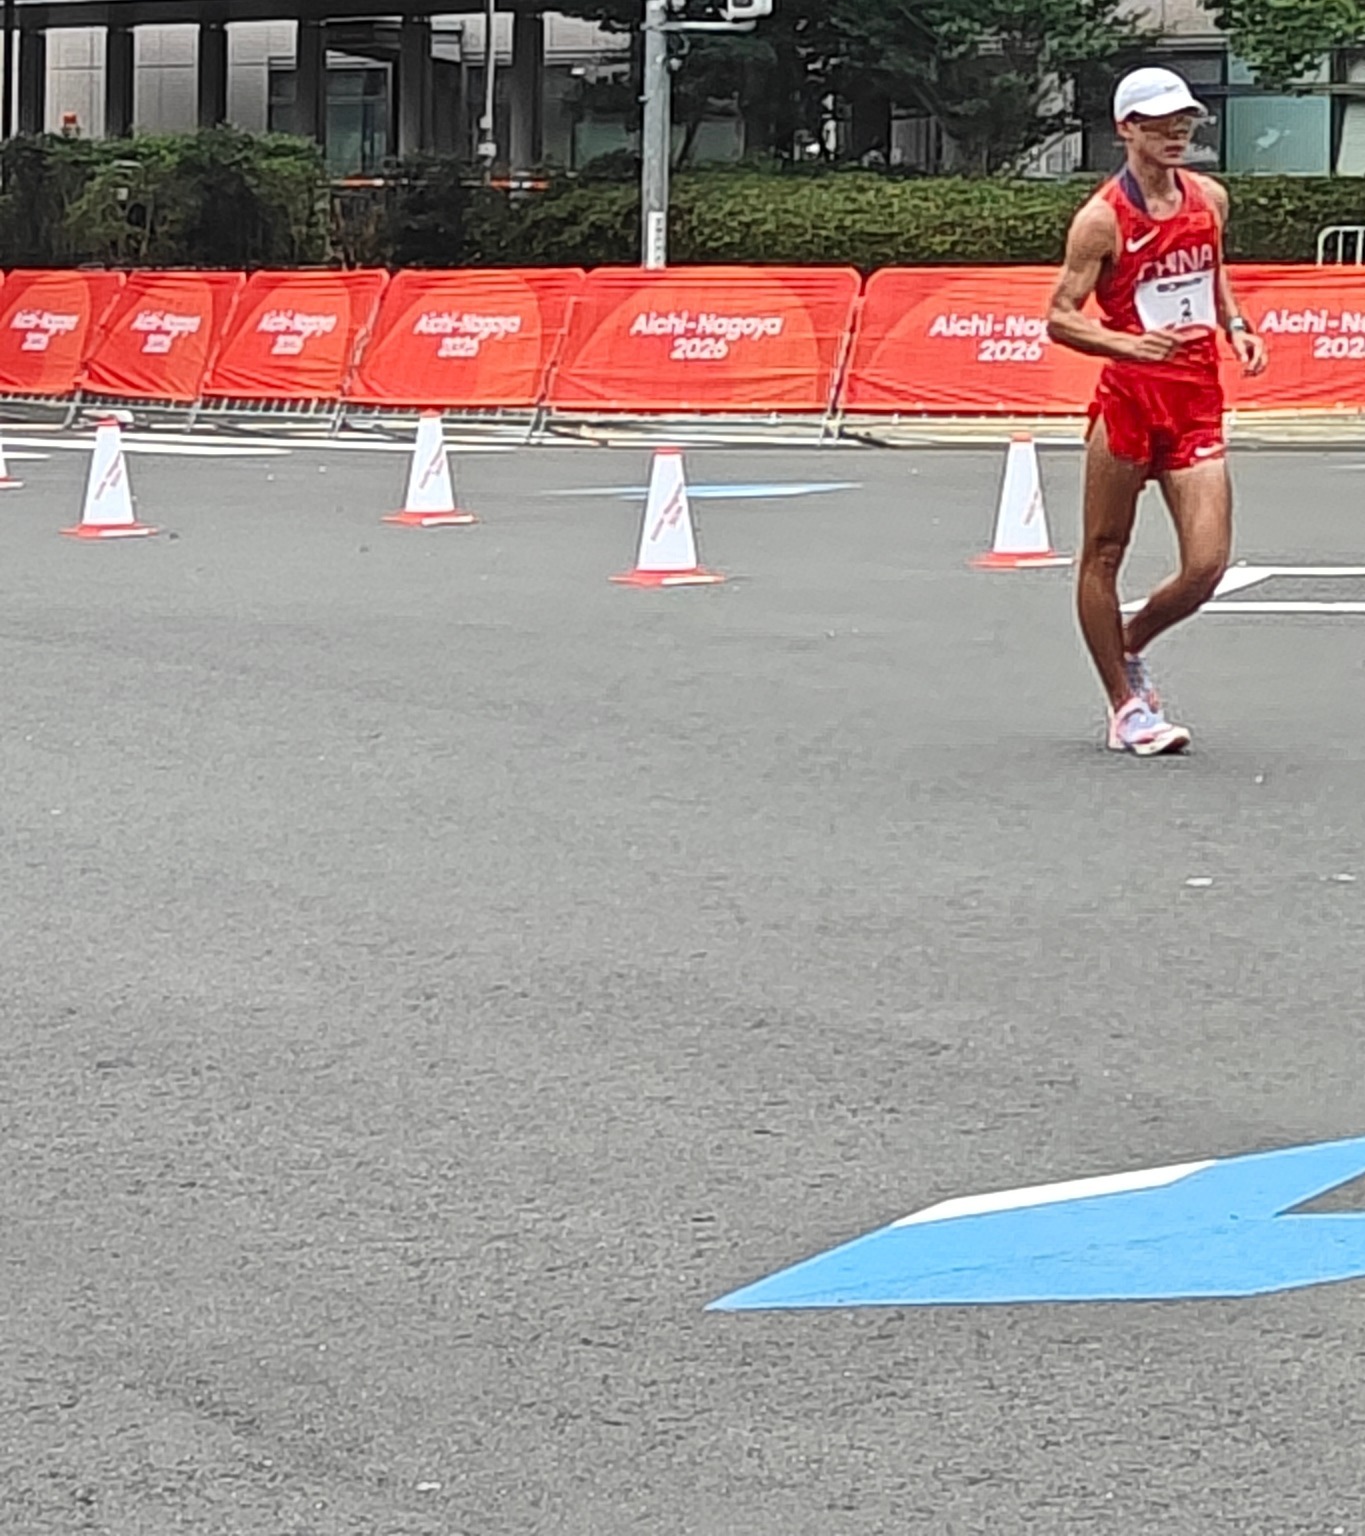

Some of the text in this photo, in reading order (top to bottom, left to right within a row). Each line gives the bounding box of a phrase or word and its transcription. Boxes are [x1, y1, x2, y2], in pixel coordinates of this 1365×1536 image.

[629, 310, 785, 341] Aichi-Nagoya
[929, 313, 1049, 344] Aichi-Nag
[670, 337, 729, 360] 2026
[978, 339, 1042, 361] 2026
